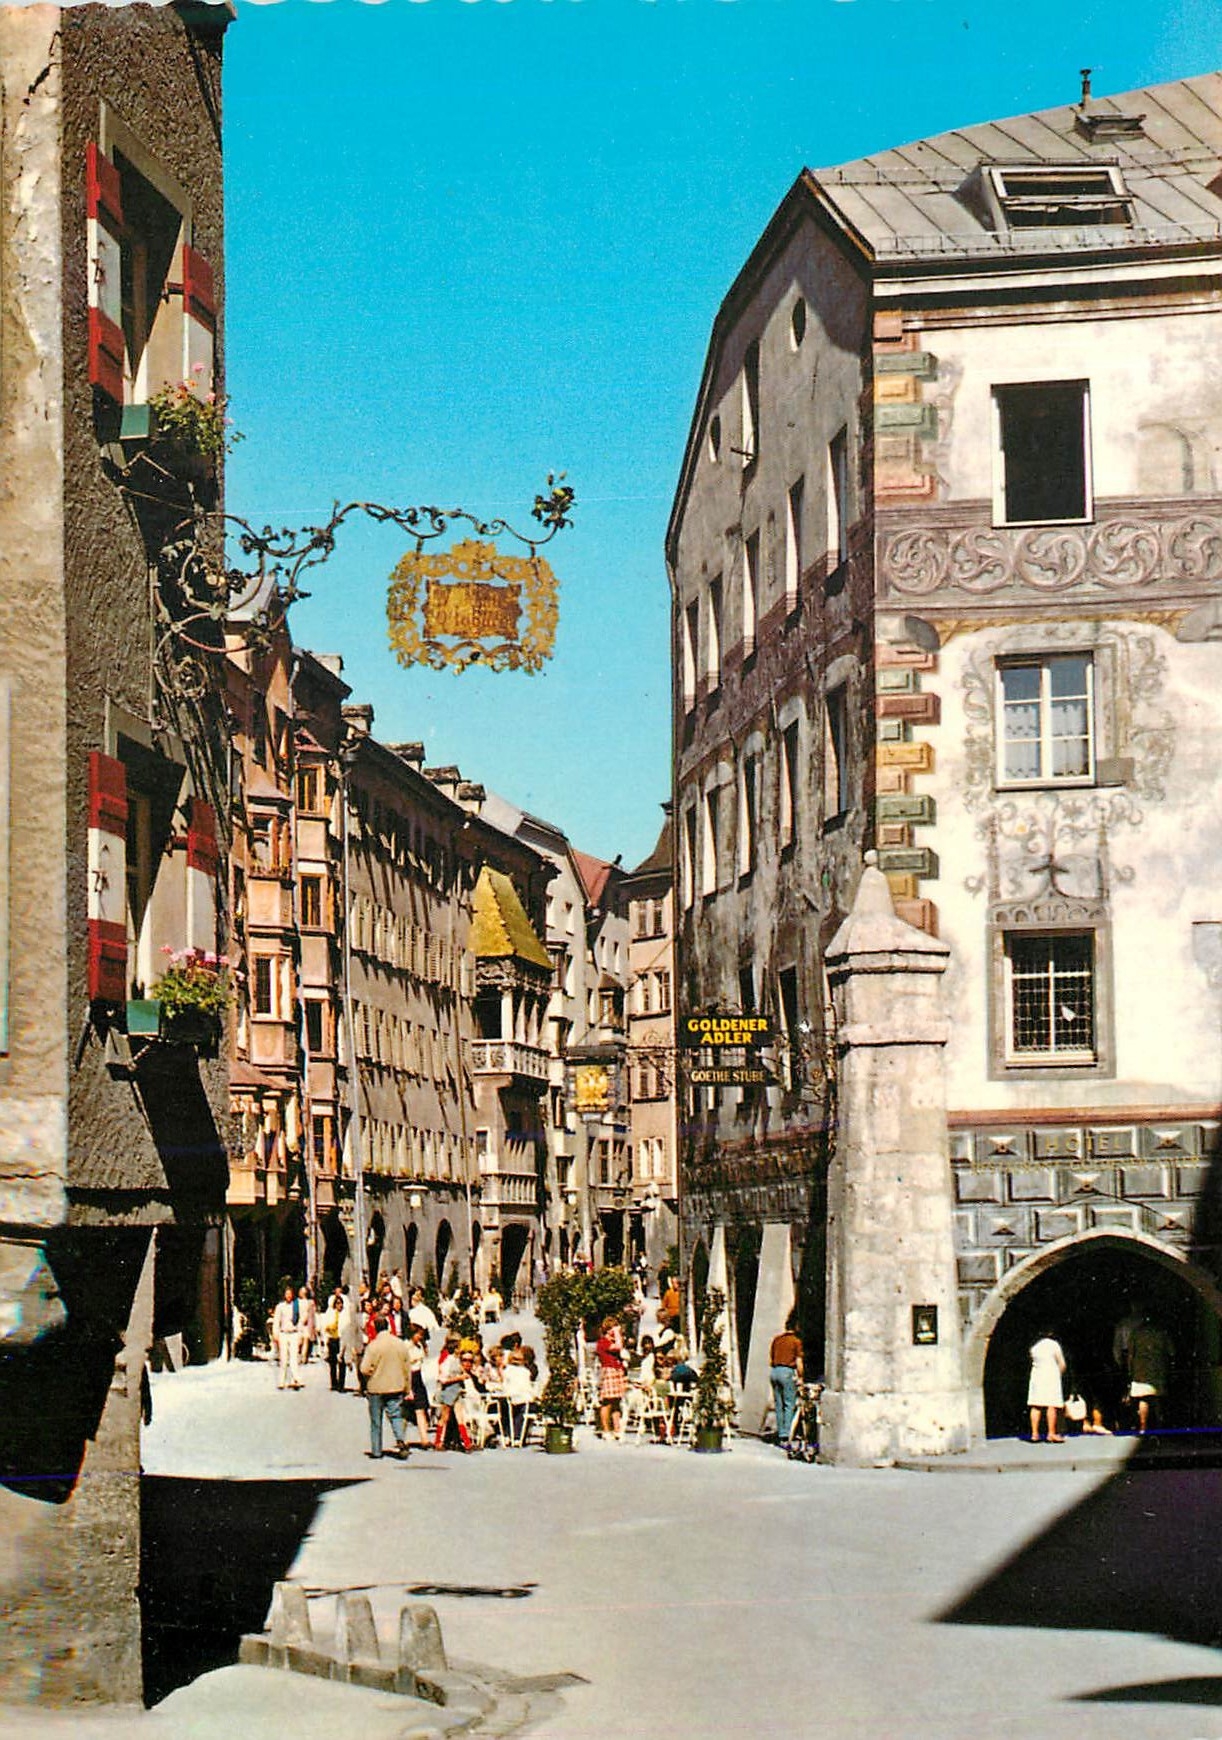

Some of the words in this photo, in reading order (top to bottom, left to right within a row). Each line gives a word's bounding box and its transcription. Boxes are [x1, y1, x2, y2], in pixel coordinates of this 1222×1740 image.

[687, 1018, 768, 1032] GOLDENER
[700, 1032, 752, 1045] ADLER
[691, 1070, 730, 1083] GOETHE
[732, 1070, 765, 1082] STUBE
[1045, 1135, 1122, 1152] HOTEL
